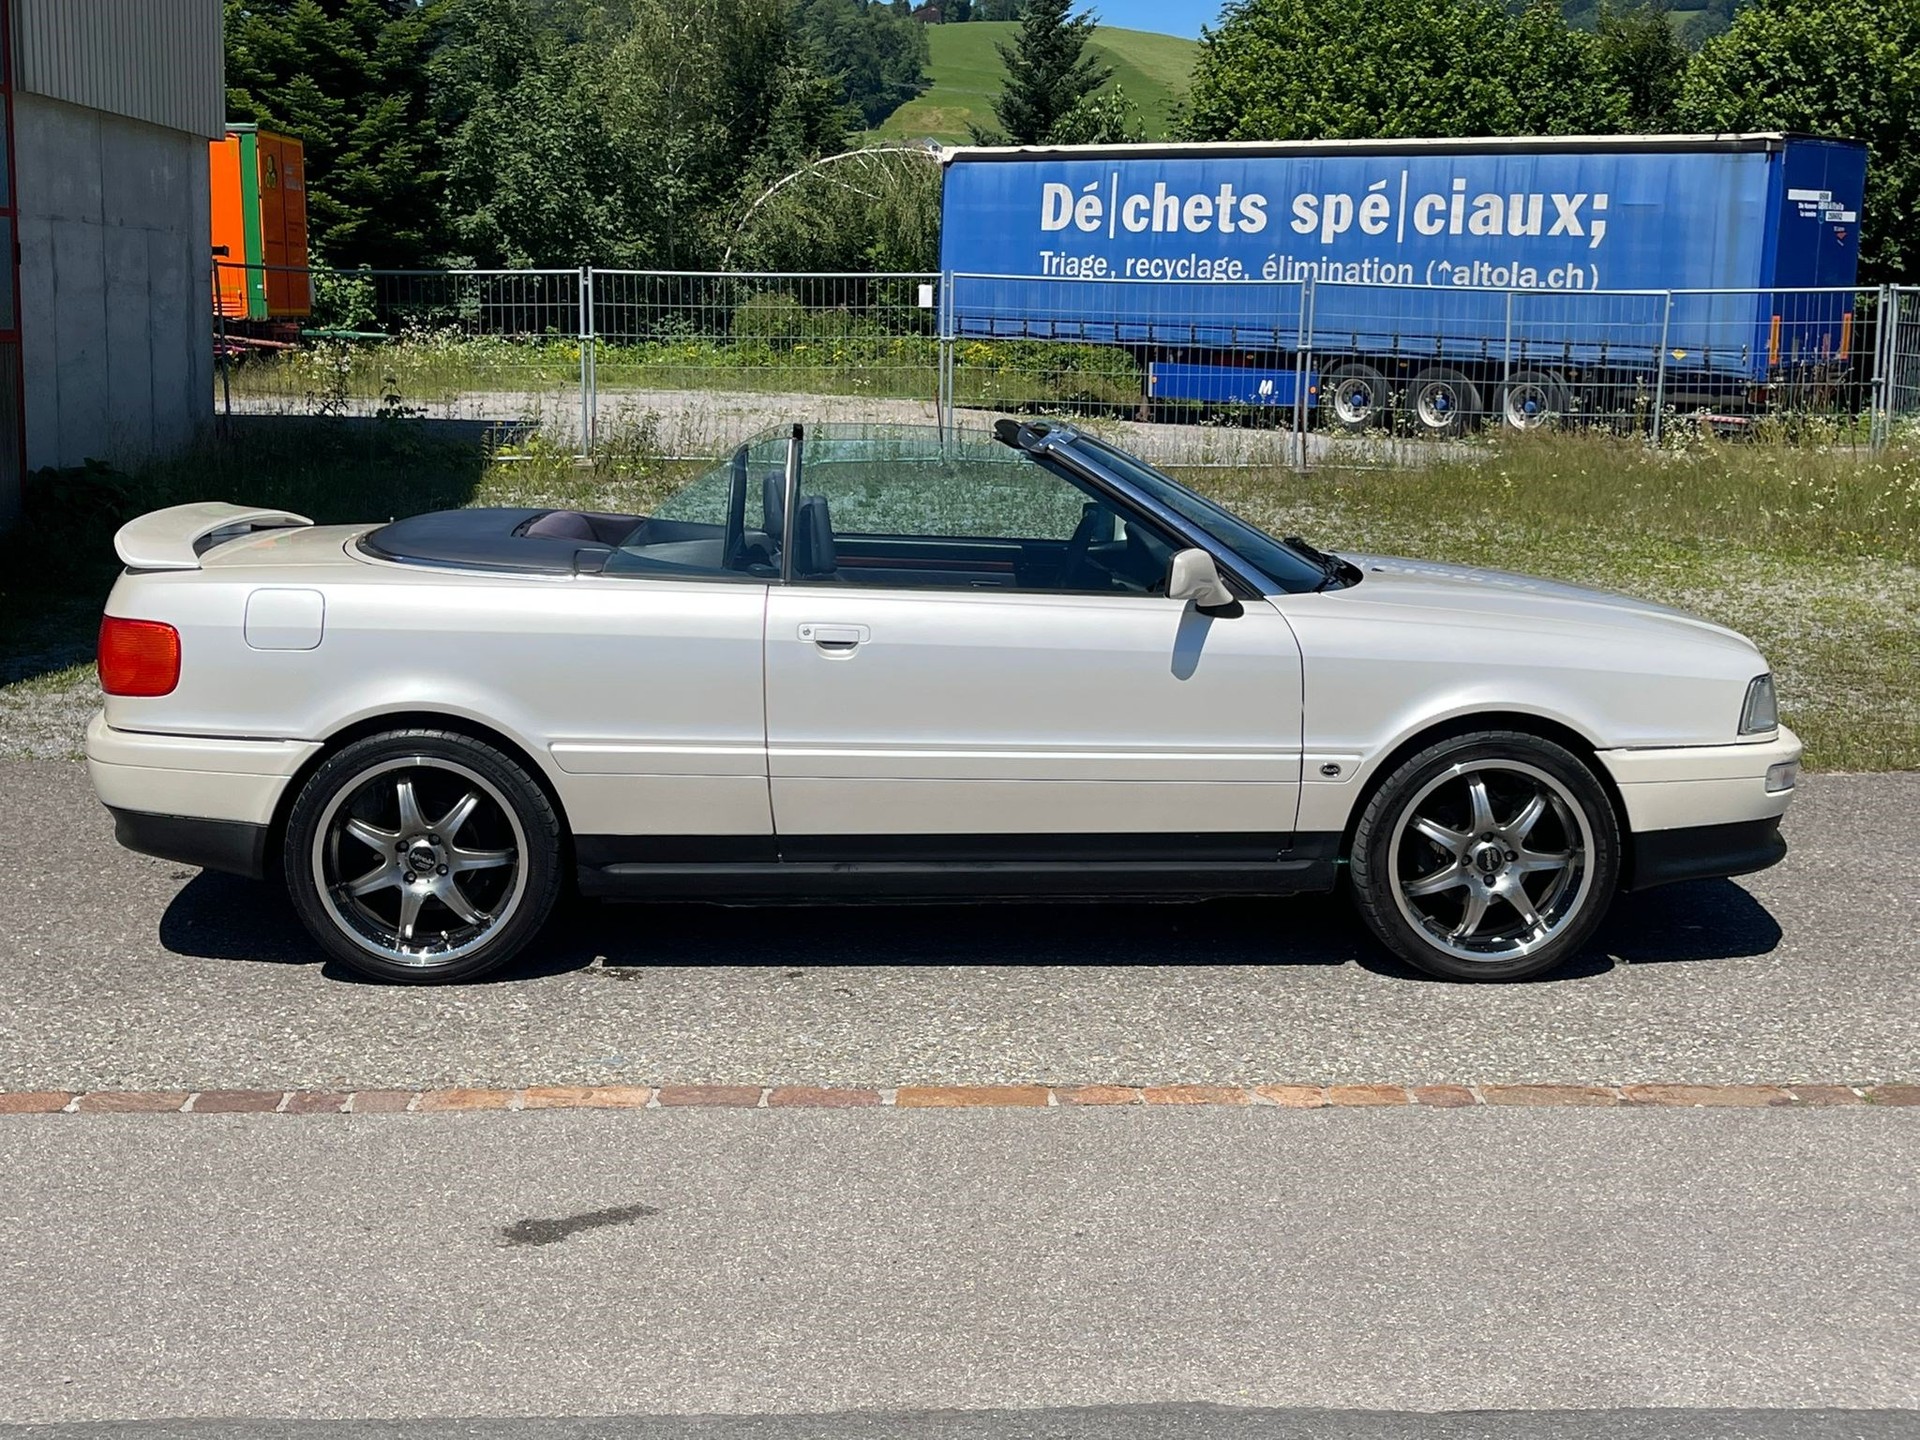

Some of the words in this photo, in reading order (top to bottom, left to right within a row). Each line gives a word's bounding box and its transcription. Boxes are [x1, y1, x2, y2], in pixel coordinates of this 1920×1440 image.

[1040, 251, 1116, 279] Triage,
[1126, 253, 1250, 281] recyclage,
[1262, 253, 1413, 285] élimination
